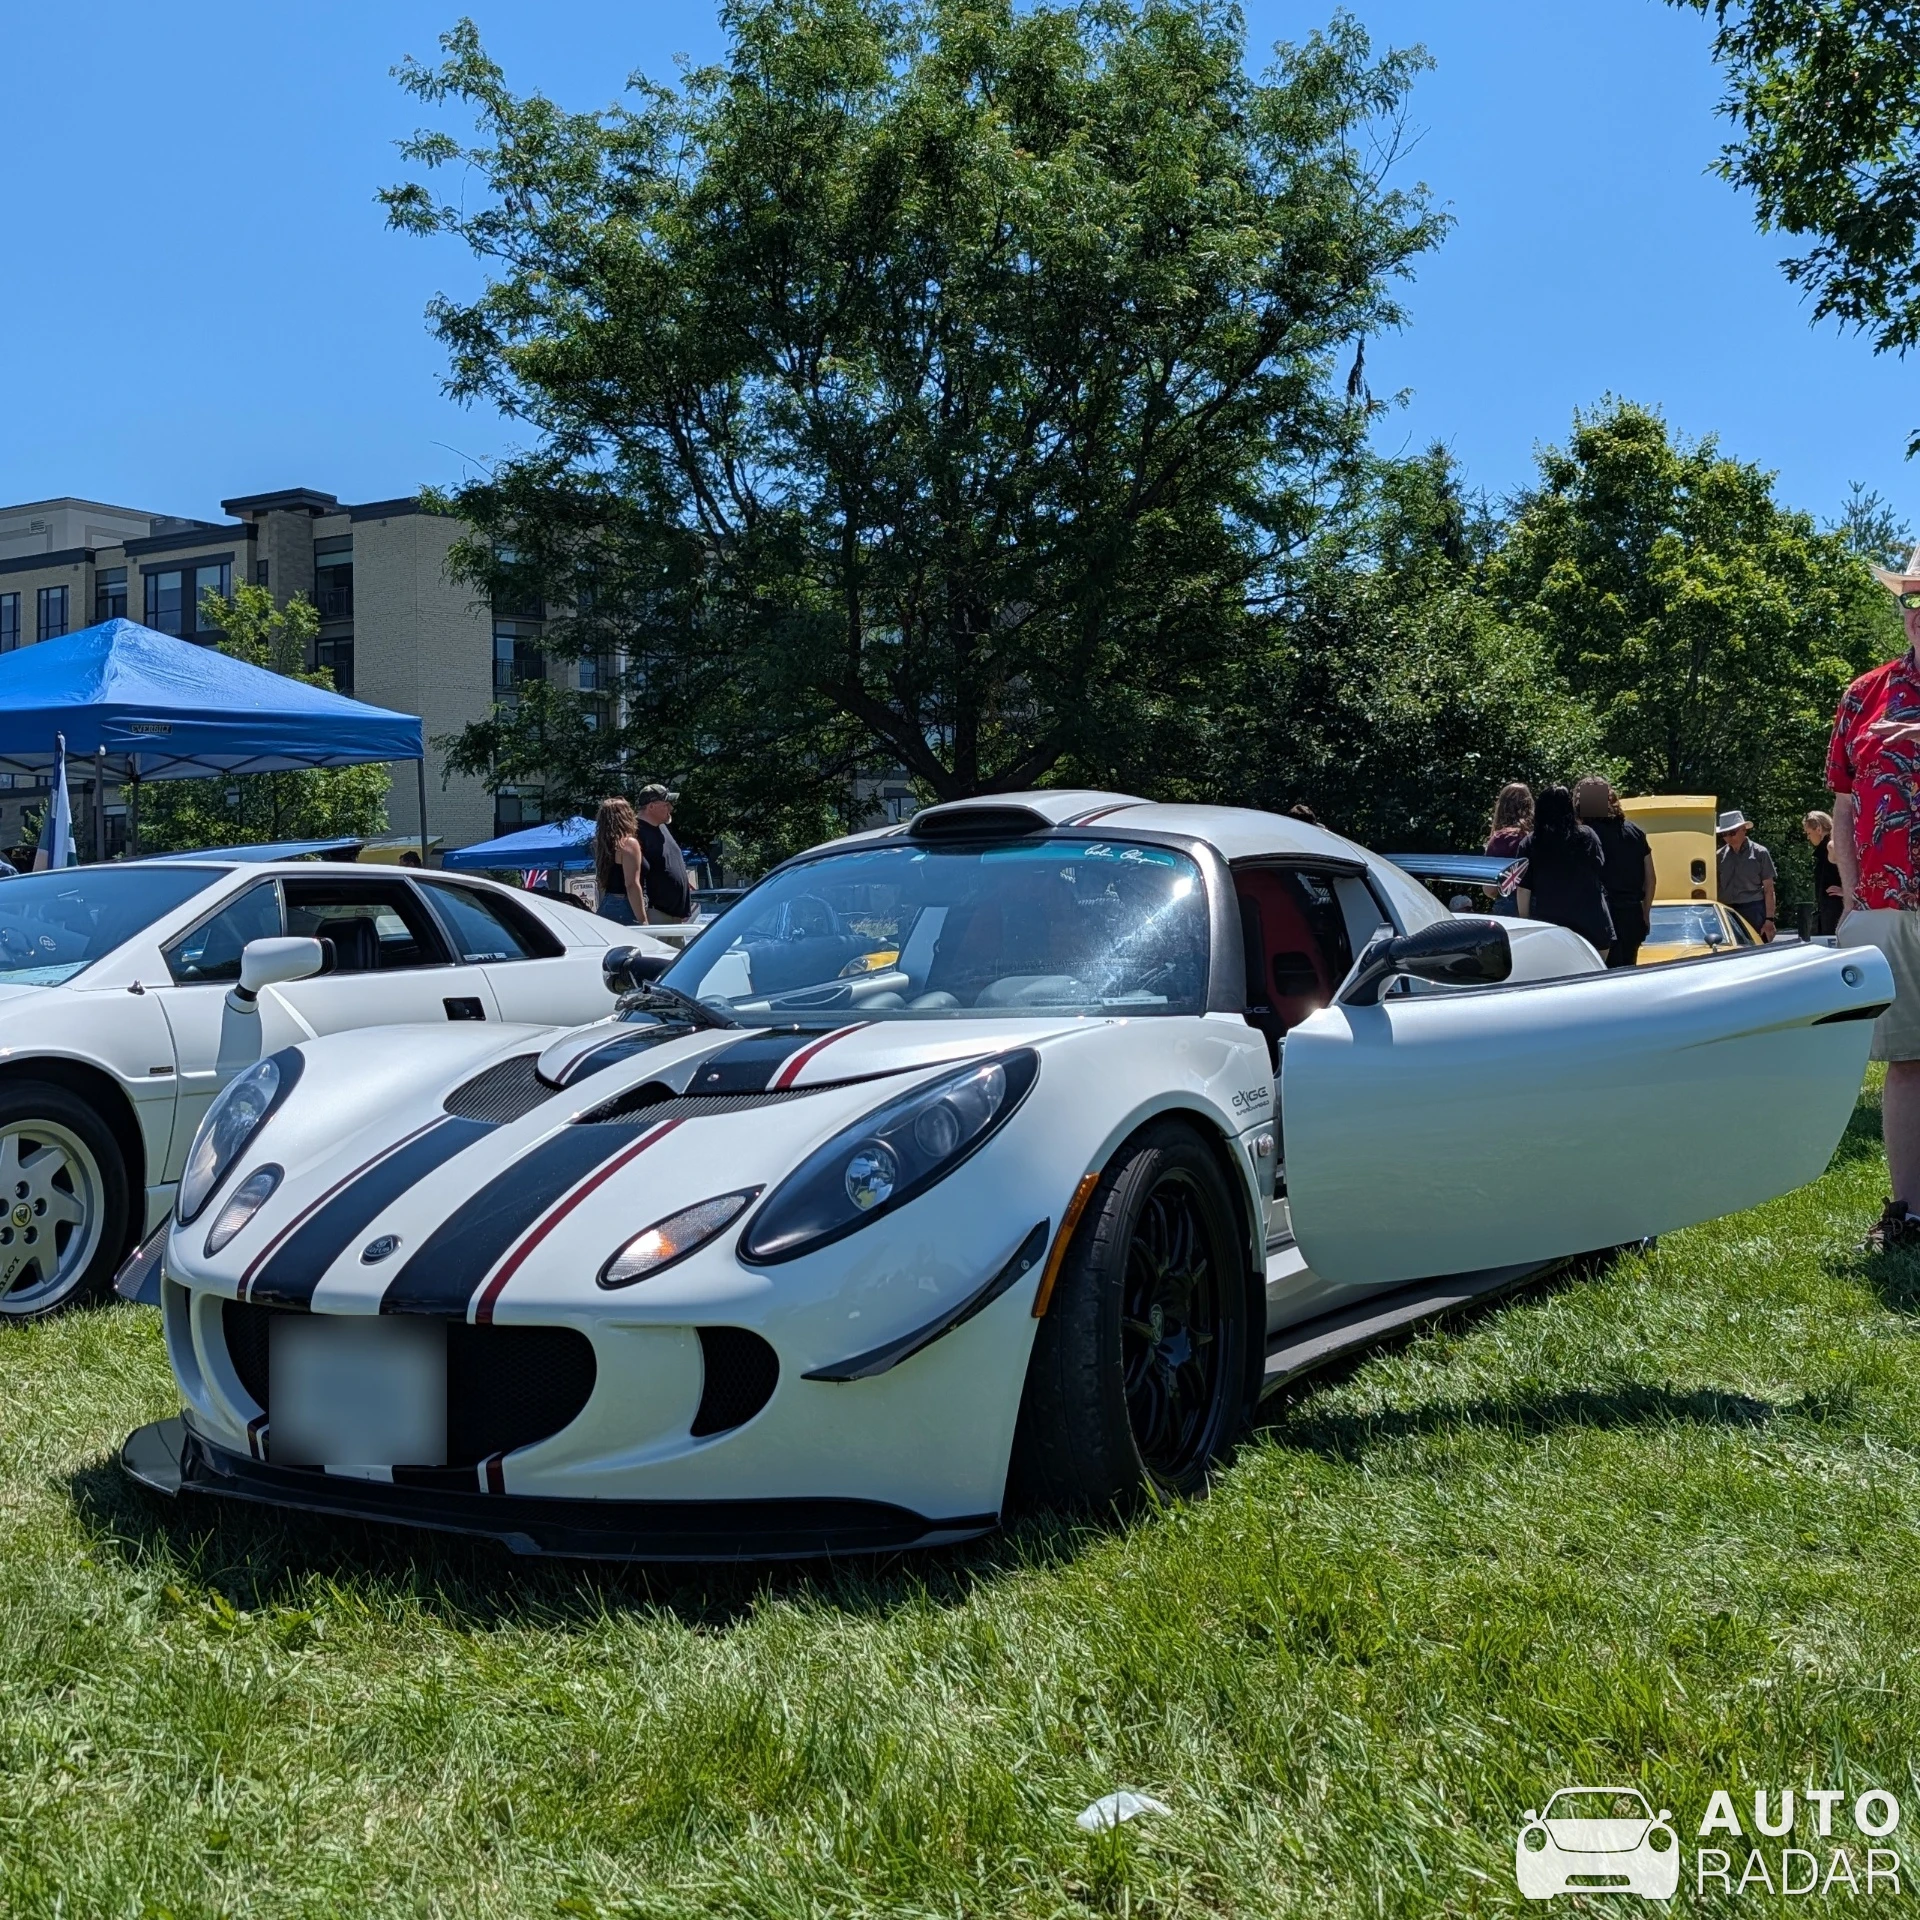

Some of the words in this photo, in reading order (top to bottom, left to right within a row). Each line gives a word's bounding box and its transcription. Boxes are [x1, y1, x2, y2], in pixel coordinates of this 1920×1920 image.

[131, 724, 170, 733] EVERBILT
[1232, 1086, 1268, 1108] EXIGE
[0, 1256, 20, 1292] LOTU
